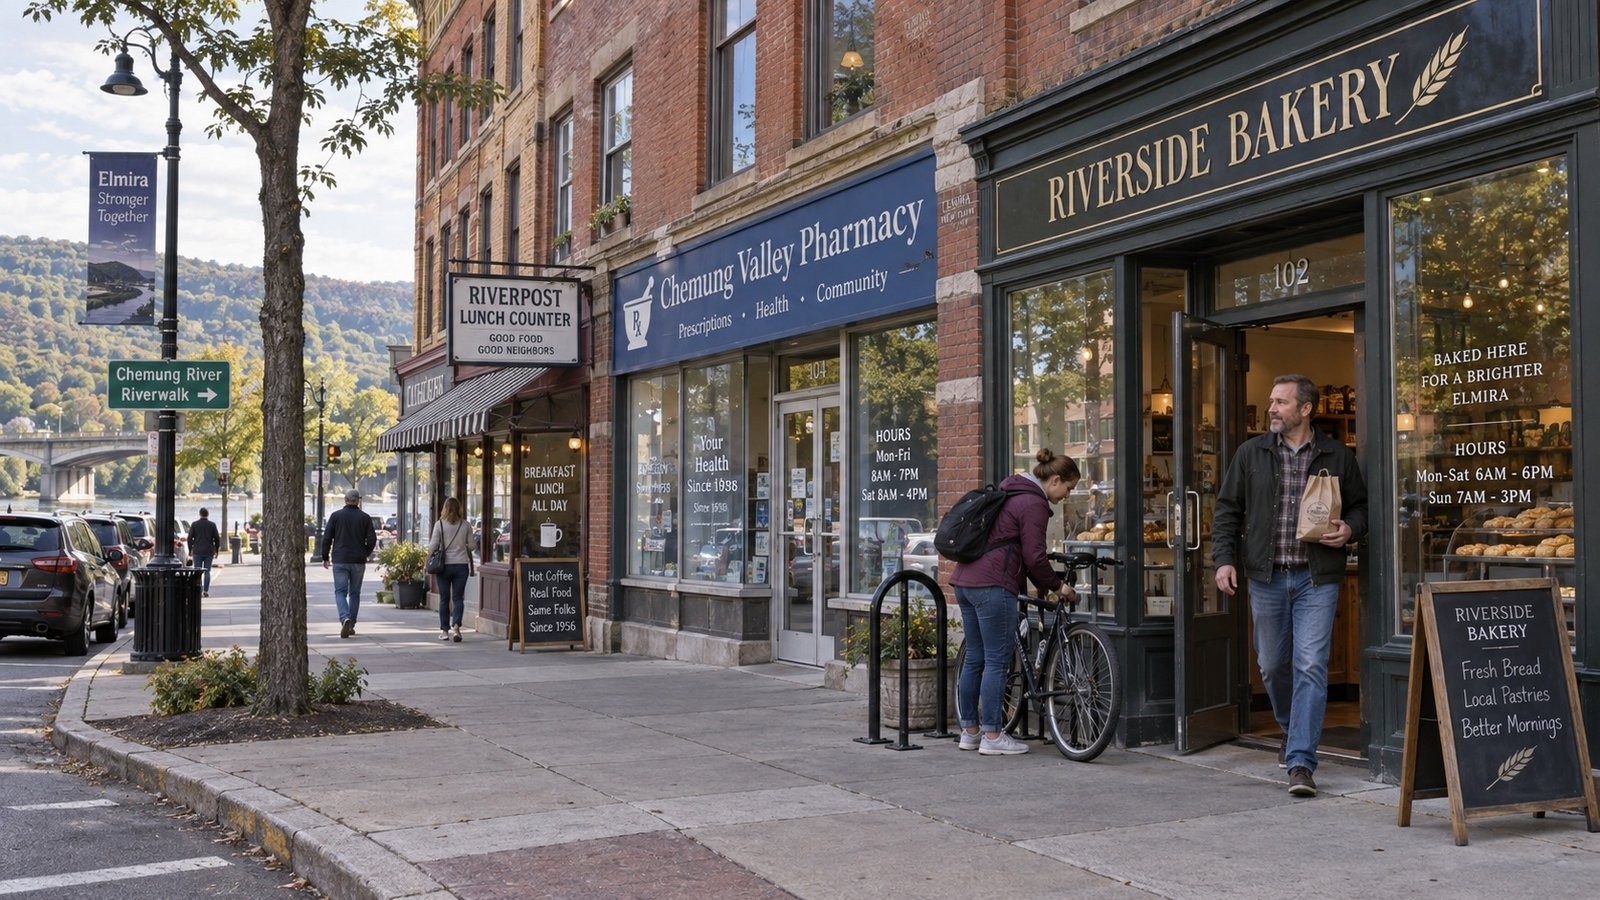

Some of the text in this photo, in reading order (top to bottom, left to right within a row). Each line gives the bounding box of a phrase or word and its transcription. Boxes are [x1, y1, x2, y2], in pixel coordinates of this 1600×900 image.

[1047, 53, 1400, 223] RIVERSIDE BAKERY
[98, 171, 149, 188] Elmira
[98, 192, 149, 208] Stronger
[97, 209, 149, 226] Together
[660, 264, 734, 309] Chemung
[737, 240, 795, 285] Valley
[799, 198, 924, 266] Pharmacy
[1273, 258, 1310, 291] 102
[469, 286, 563, 307] RIVERPOST
[678, 268, 888, 339] Prescriptions Health Community
[460, 310, 571, 327] LUNCH COUNTER
[489, 334, 543, 344] GOOD FOOD
[478, 345, 555, 355] GOOD NEIGHBORS
[1434, 342, 1528, 366] BAKED HERE
[116, 367, 222, 385] Chemung River
[808, 360, 827, 380] 104
[1421, 362, 1543, 388] FOR A BRIGHTER
[121, 388, 190, 402] Riverwalk
[1452, 388, 1509, 406] ELMIRA
[700, 435, 723, 451] Your
[876, 428, 911, 442] HOURS
[876, 448, 911, 463] Mon-Fri
[1455, 440, 1506, 457] HOURS
[524, 465, 576, 479] BREAKFAST
[695, 455, 729, 473] Health
[871, 470, 891, 482] 8AM
[899, 468, 919, 481] 7PM
[1416, 469, 1470, 482] Mon-Sat
[1475, 467, 1507, 480] 6AM
[1522, 465, 1553, 479] 6PM
[535, 482, 564, 495] LUNCH
[687, 479, 712, 492] Since
[862, 489, 877, 501] Sat
[878, 488, 898, 501] 8AM
[906, 488, 927, 500] 4PM
[1429, 491, 1452, 504] Sun
[1456, 490, 1486, 504] 7AM
[1501, 489, 1531, 503] 3PM
[531, 500, 568, 512] ALL DAY
[528, 570, 573, 584] Hot Coffee
[530, 587, 572, 598] Real Food
[528, 604, 576, 616] Same Folks
[1455, 604, 1534, 622] RIVERSIDE
[530, 620, 576, 633] Since 1956
[1468, 624, 1527, 641] BAKERY
[1461, 656, 1541, 680] Fresh Bread
[1463, 685, 1550, 708] Local Pastries
[1461, 713, 1563, 739] Better Mornings
